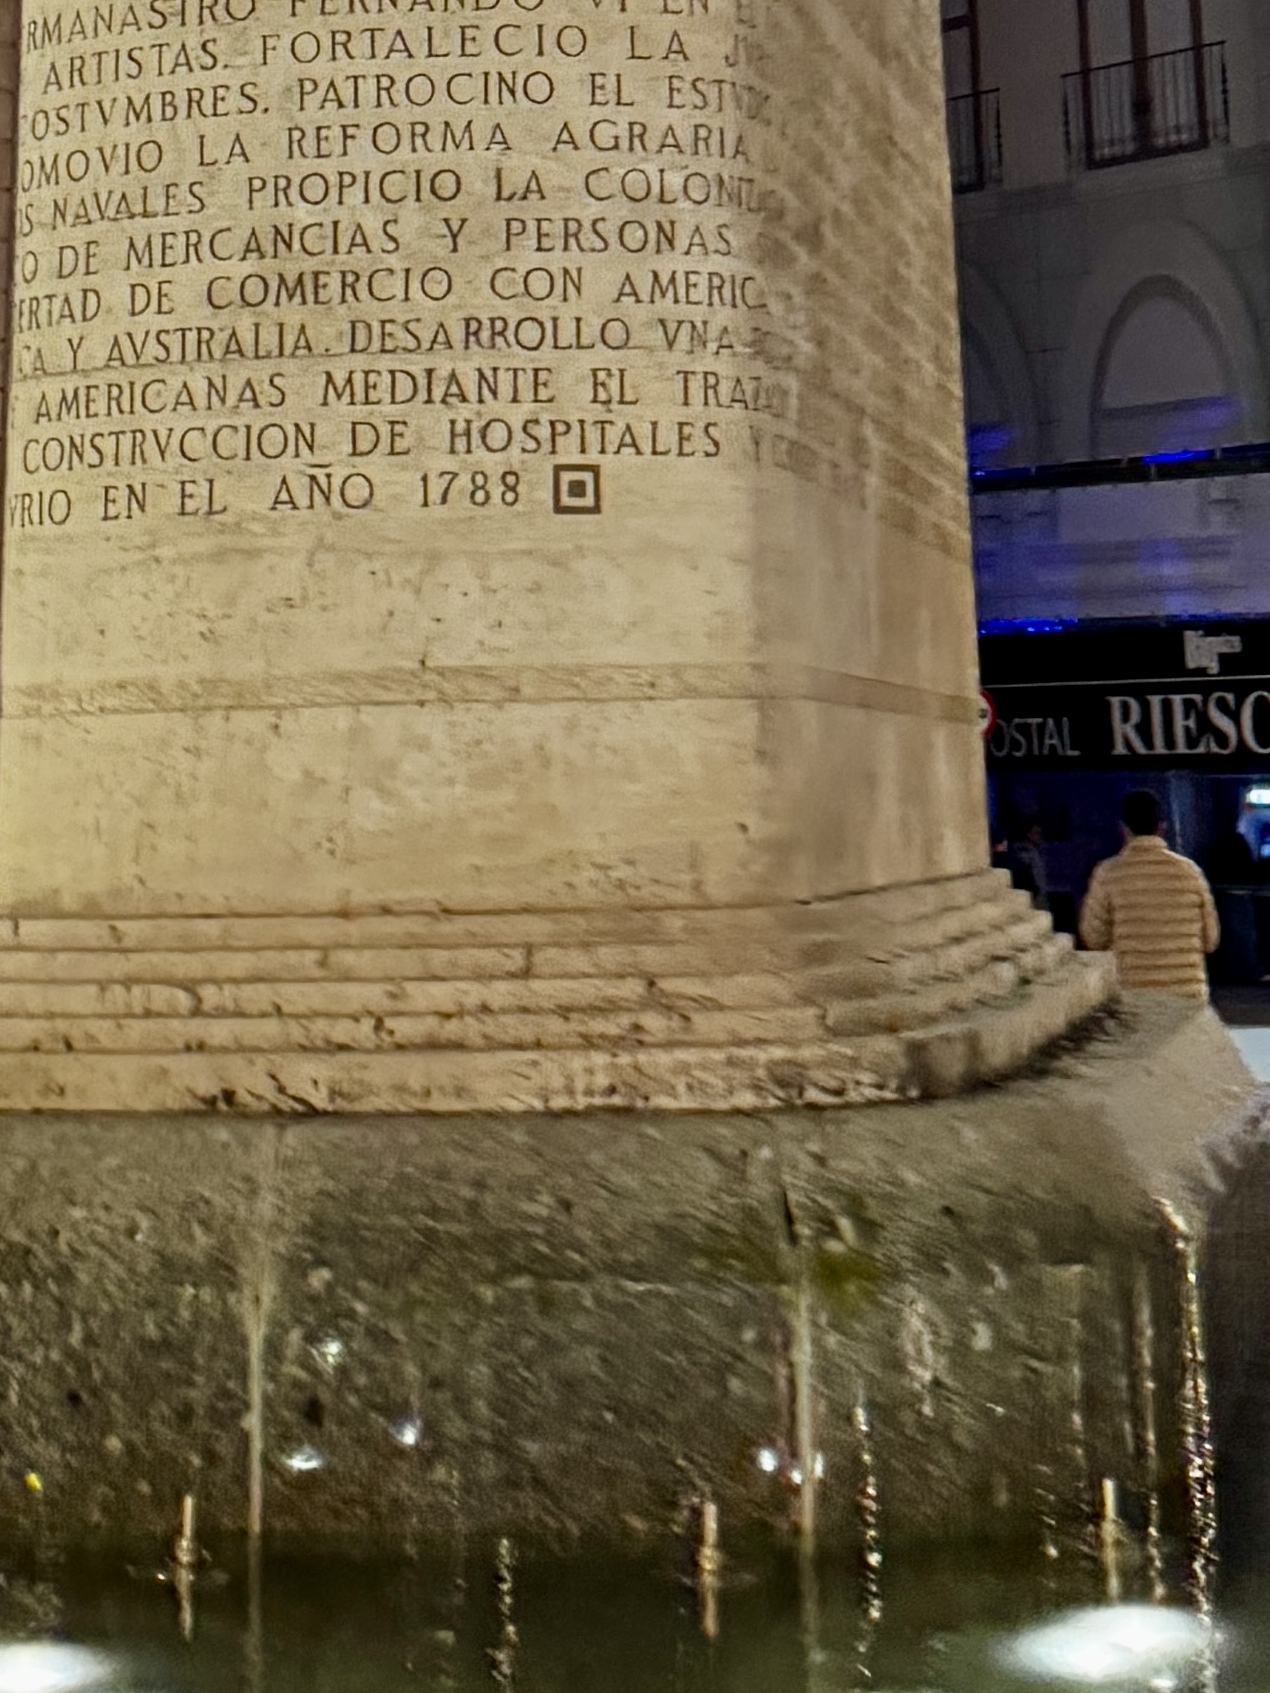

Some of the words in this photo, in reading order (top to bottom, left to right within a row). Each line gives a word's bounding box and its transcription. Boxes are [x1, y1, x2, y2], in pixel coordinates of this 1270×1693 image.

[42, 36, 231, 95] ARTISTAS.
[259, 22, 589, 68] FORTALECIO
[626, 26, 691, 63] LA
[295, 70, 556, 112] PATROCINO
[588, 73, 635, 108] EL
[21, 139, 163, 193] OMOVIO
[198, 132, 249, 168] LA
[285, 119, 513, 162] REFORMA
[552, 119, 750, 164] AGRARIA
[51, 180, 206, 231] NAVALES
[246, 169, 463, 212] PROPICIO
[494, 168, 546, 204] LA
[57, 240, 100, 281] DE
[124, 218, 401, 272] MERCANCIAS
[437, 217, 470, 253] Y
[503, 218, 733, 257] PERSONAS
[128, 279, 175, 318] DE
[206, 266, 454, 311] COMERCIO
[489, 264, 585, 302] CON
[66, 335, 86, 371] Y
[106, 322, 330, 370] AVSTRALIA.
[348, 315, 632, 356] DESARROLLO
[658, 317, 735, 356] VNA
[34, 372, 288, 425] AMERICANAS
[321, 368, 556, 410] MEDIANTE
[589, 368, 639, 409] EL
[23, 422, 318, 475] CONSTRVCCION
[349, 420, 412, 460] DE
[449, 418, 722, 459] HOSPITALES
[101, 480, 148, 522] EN
[178, 478, 228, 519] EL
[270, 461, 375, 512] AÑO
[420, 470, 522, 509] 1788
